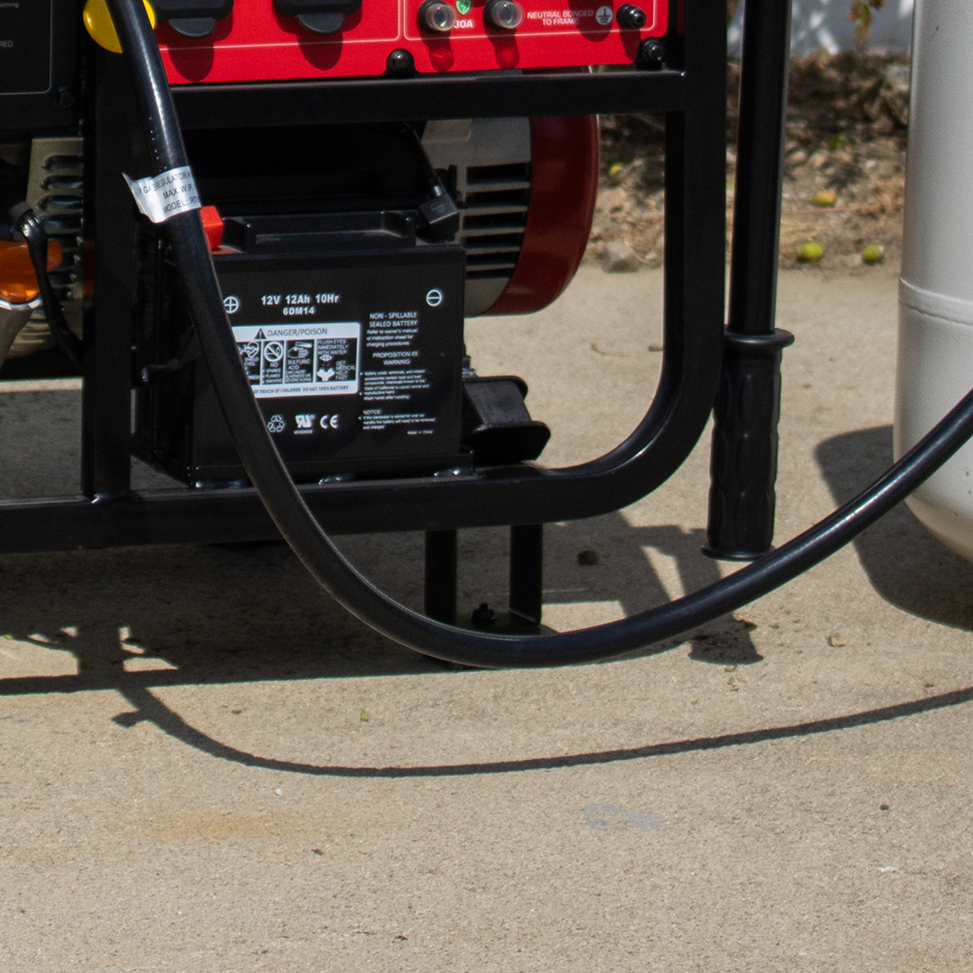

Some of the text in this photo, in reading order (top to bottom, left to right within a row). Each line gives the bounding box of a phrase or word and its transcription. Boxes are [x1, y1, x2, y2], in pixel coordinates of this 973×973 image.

[527, 11, 562, 20] NEUTRAL
[454, 20, 473, 29] 30A
[542, 18, 552, 26] TO
[163, 187, 179, 199] MAX
[261, 293, 340, 305] 12V 12Ah 10Hr
[283, 306, 316, 316] 6DM14
[369, 319, 418, 328] SEALED BATTERY
[267, 328, 328, 337] DANGER/POISON
